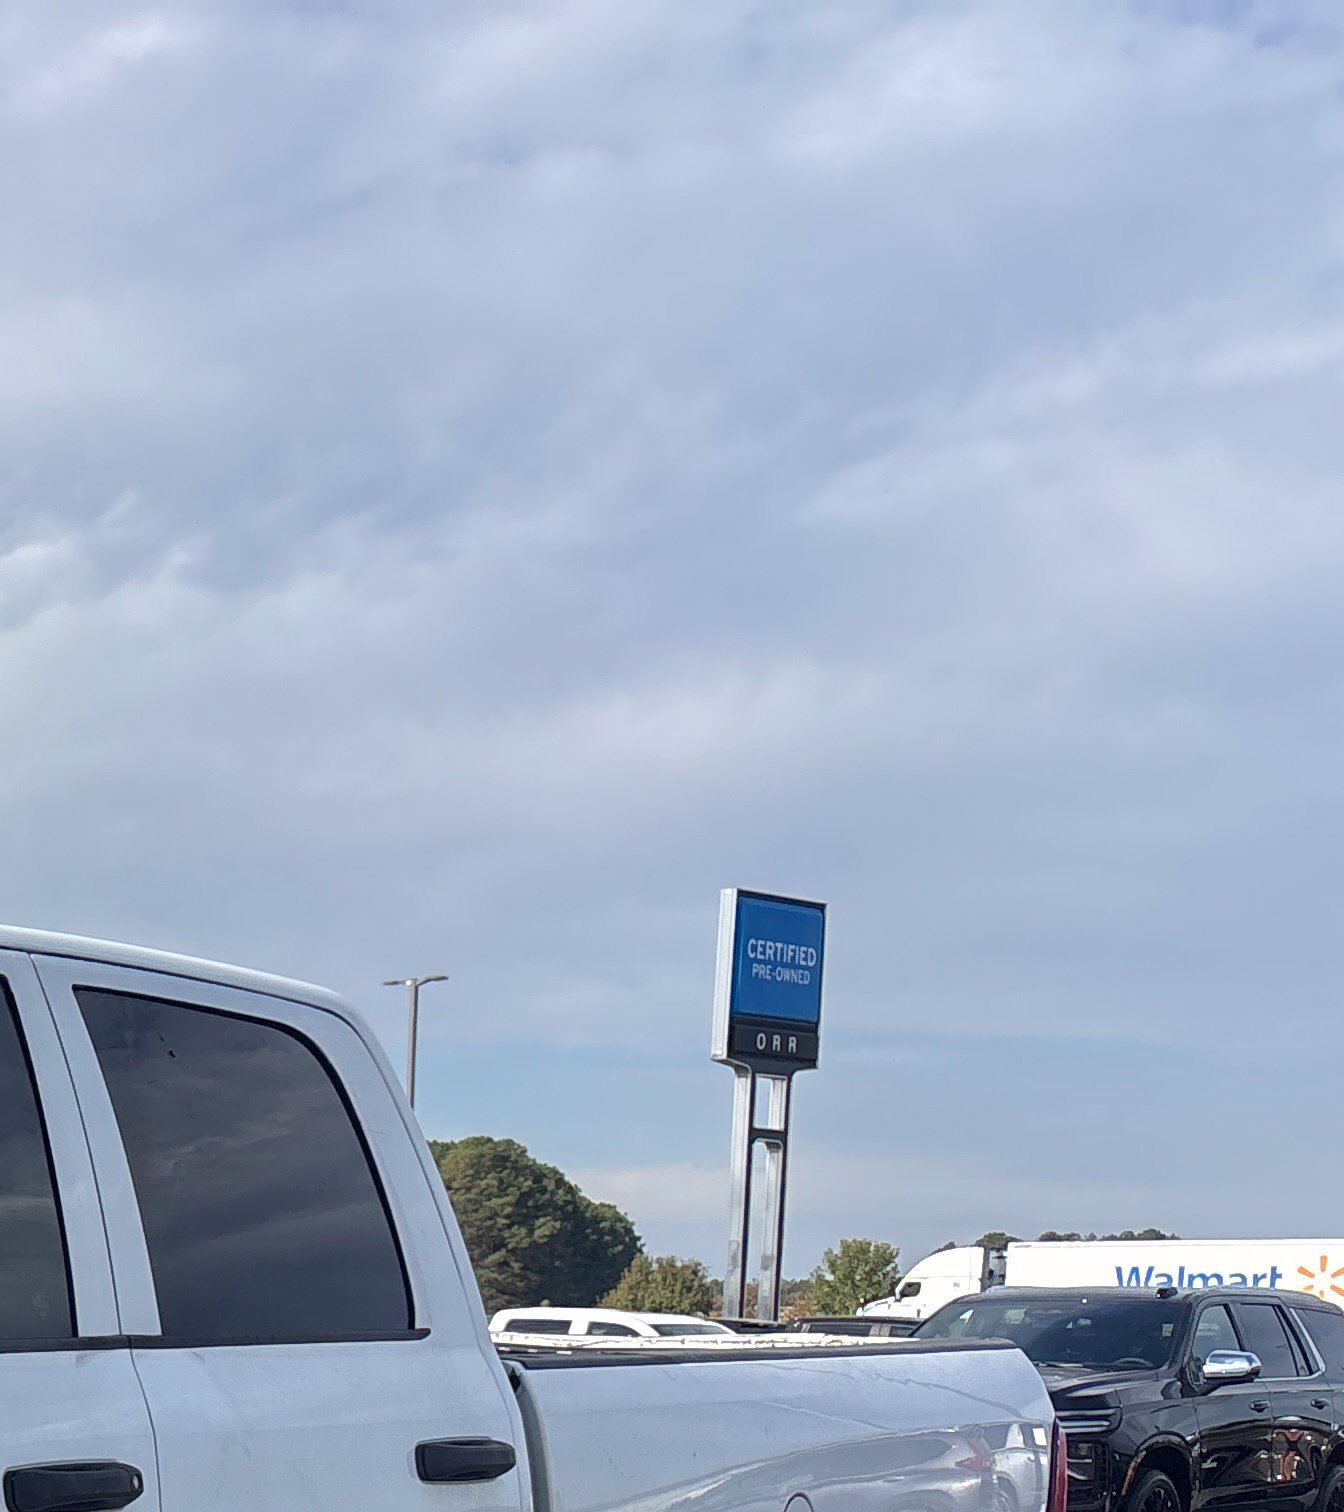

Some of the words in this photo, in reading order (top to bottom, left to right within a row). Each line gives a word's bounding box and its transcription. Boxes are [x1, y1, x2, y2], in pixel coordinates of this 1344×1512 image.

[747, 938, 817, 967] CERTIFIED
[751, 963, 811, 985] PRE-OWNED
[756, 1032, 797, 1054] ORR
[1115, 1265, 1283, 1289] Walmart
